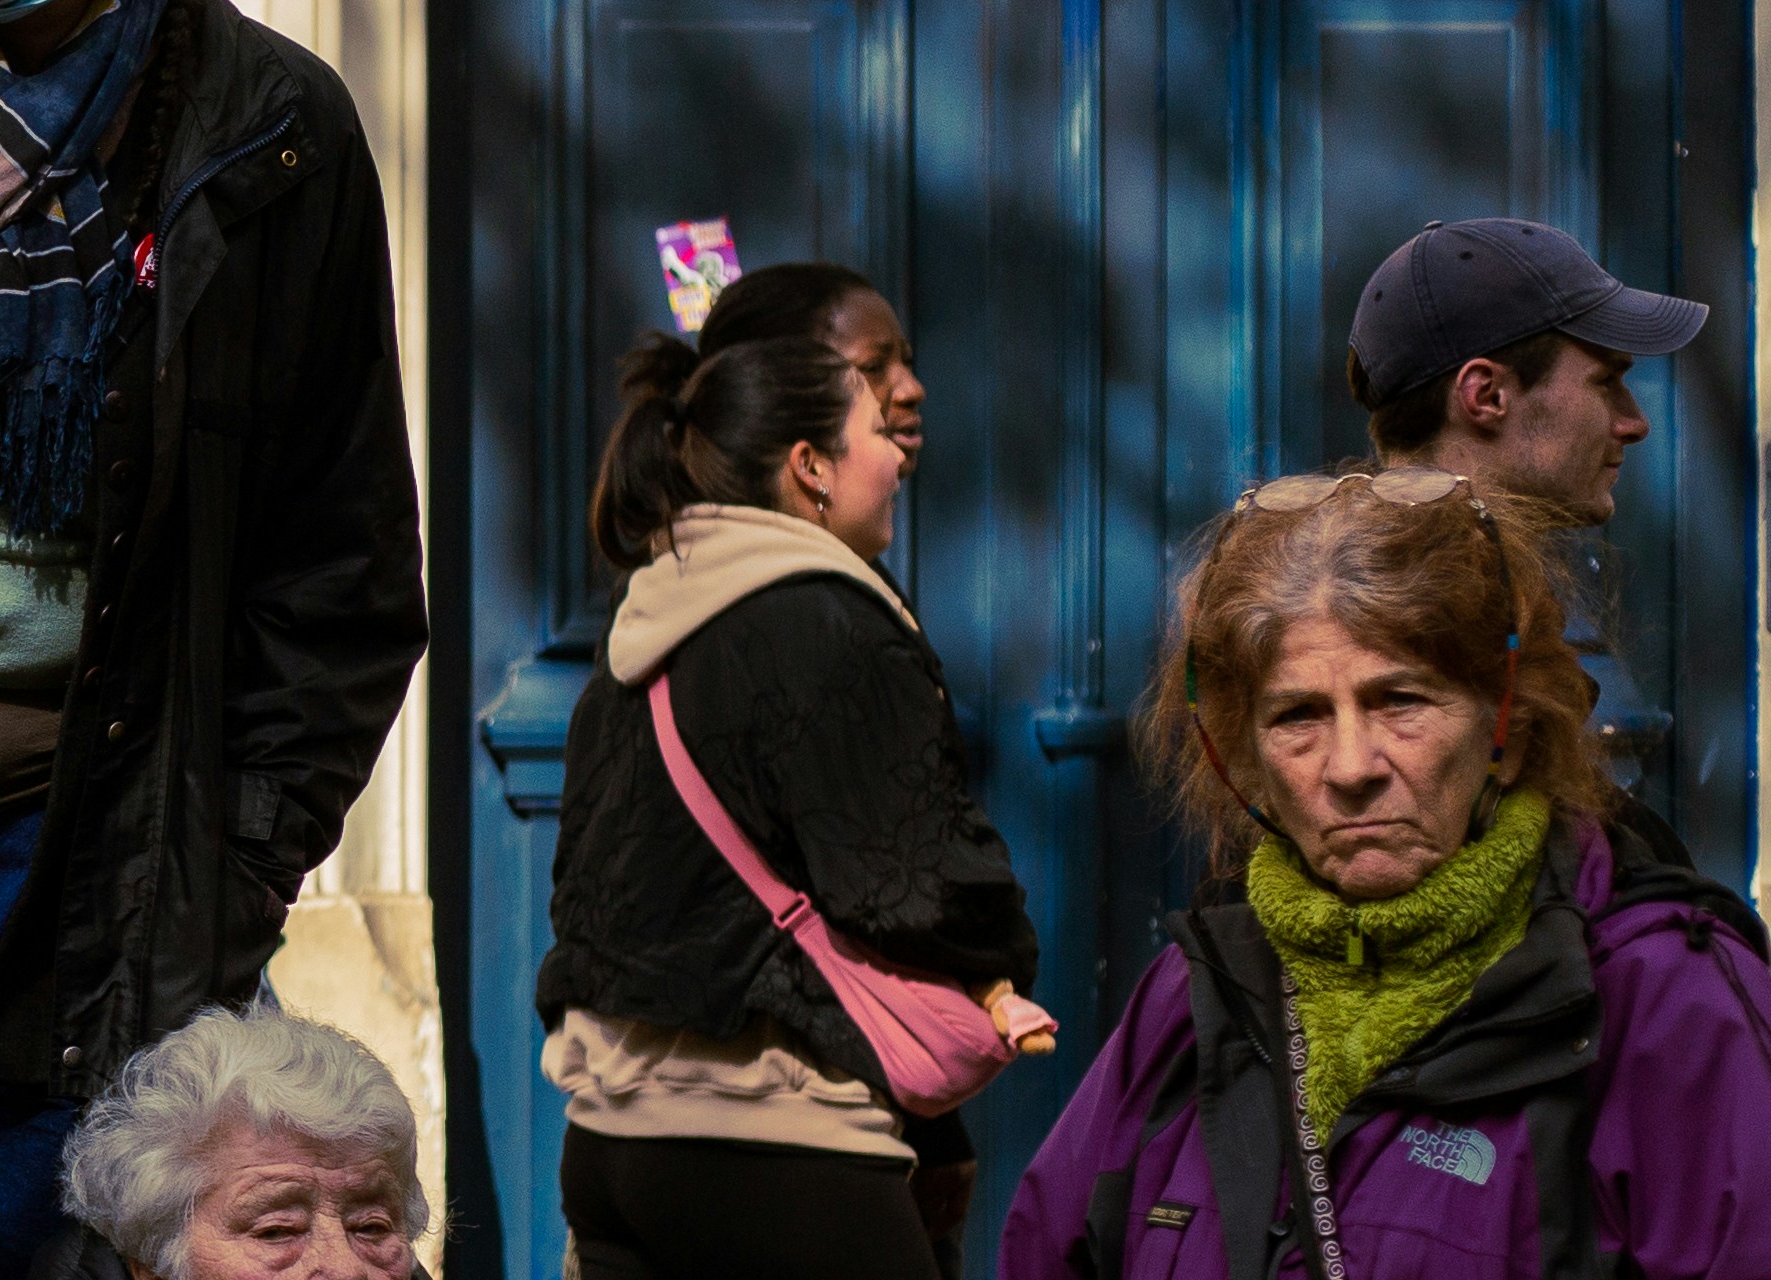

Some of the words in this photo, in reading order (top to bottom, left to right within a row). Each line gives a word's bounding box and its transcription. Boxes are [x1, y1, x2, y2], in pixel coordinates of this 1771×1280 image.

[1399, 1124, 1465, 1160] NORTH
[1437, 1119, 1472, 1143] THE
[1405, 1146, 1460, 1174] FACE
